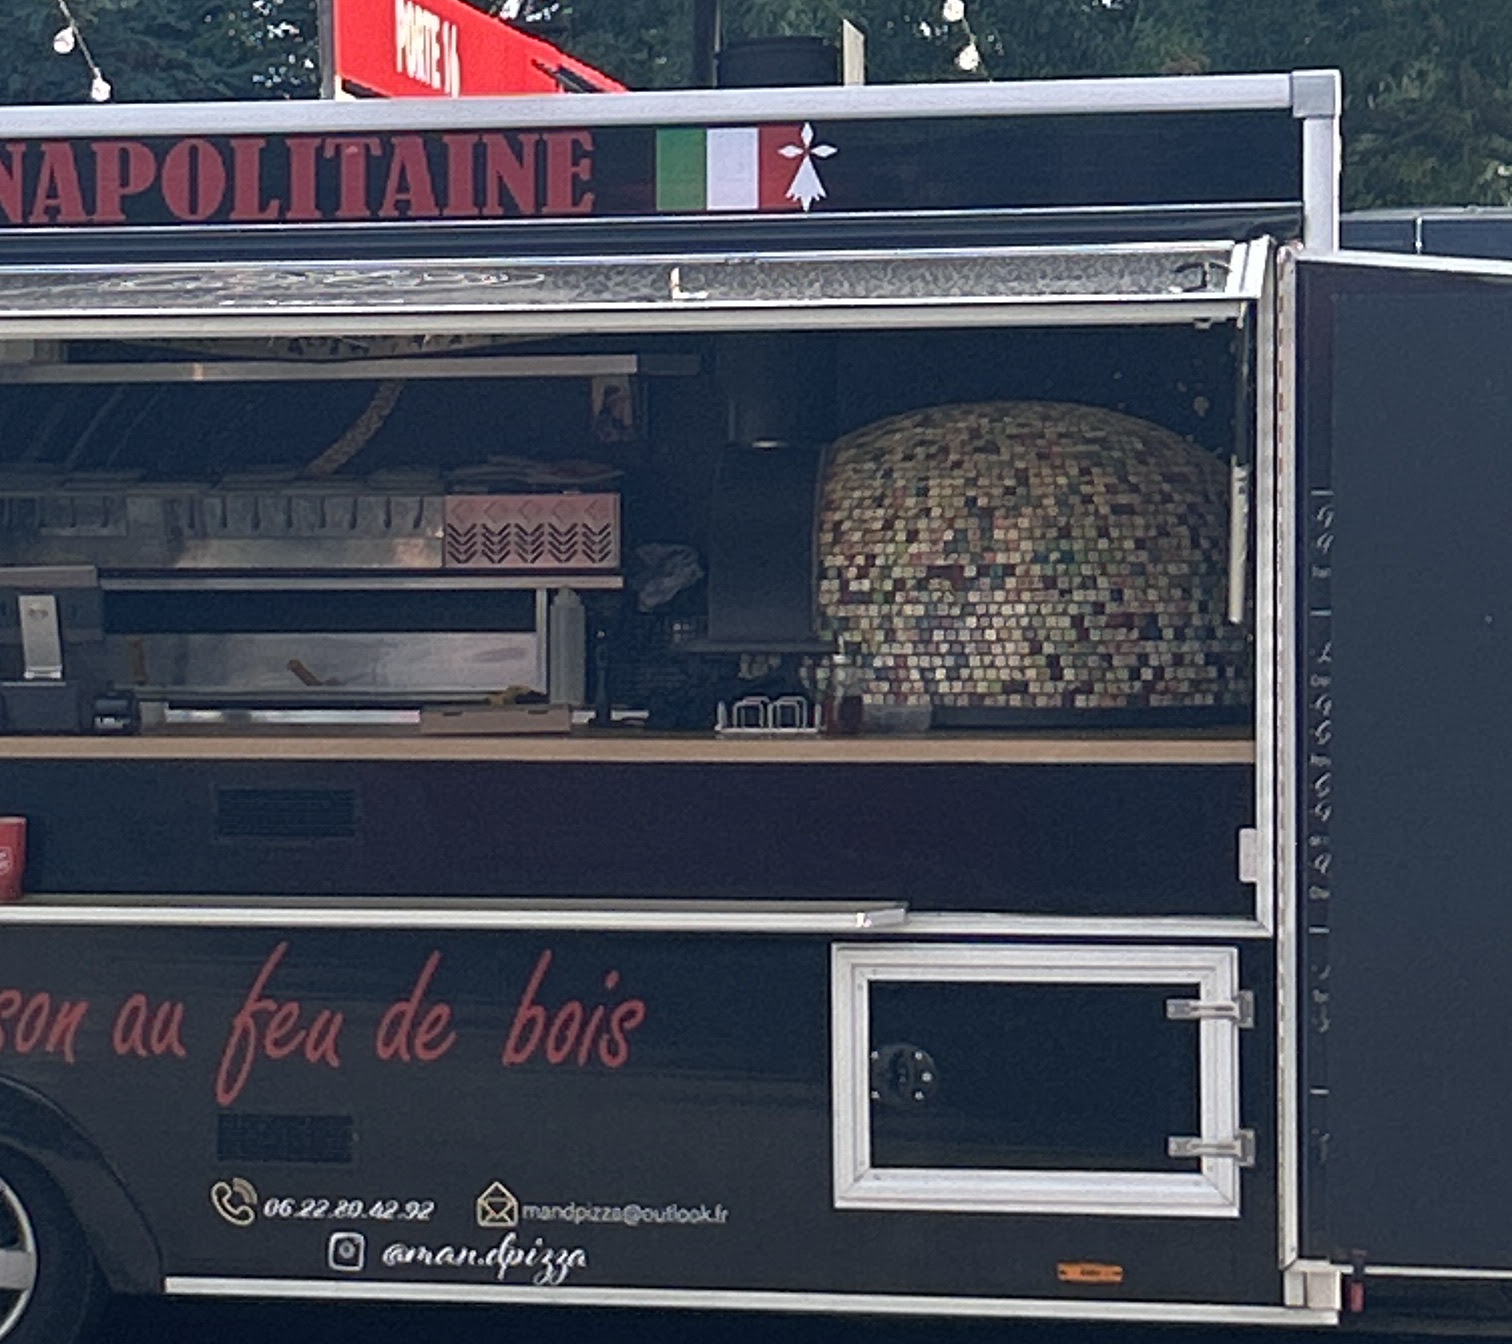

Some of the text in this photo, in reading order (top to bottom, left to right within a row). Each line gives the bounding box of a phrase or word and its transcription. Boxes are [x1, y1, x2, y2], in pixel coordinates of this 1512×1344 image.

[113, 992, 187, 1058] au
[215, 942, 343, 1107] feu
[375, 951, 457, 1063] de
[500, 949, 647, 1069] bois
[522, 1202, 730, 1227] mandpizza@outlook.fr
